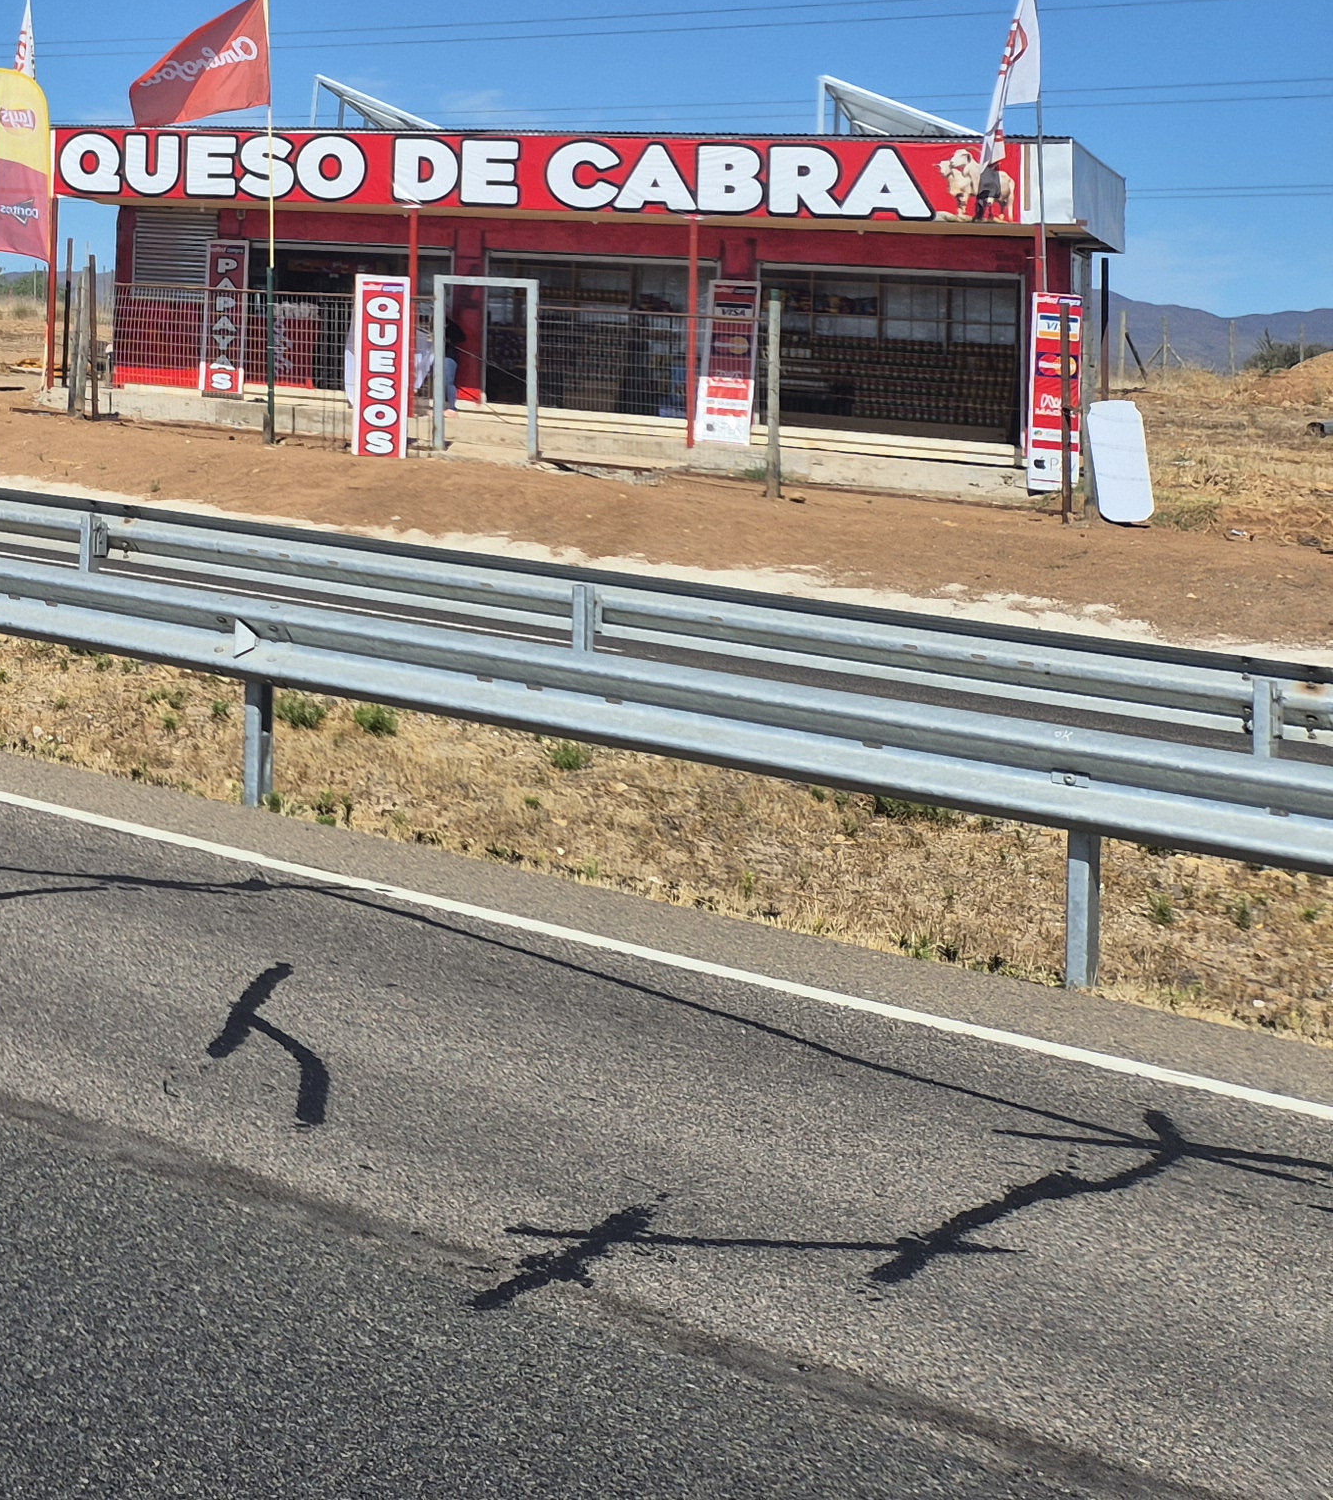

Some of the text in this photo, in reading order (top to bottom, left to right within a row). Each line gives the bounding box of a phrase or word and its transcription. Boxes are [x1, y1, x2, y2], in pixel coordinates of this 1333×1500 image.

[58, 131, 934, 220] QUESO DE CABRA
[209, 257, 238, 390] PAPAYAS
[720, 308, 746, 317] VISA
[1045, 321, 1073, 332] VIA
[362, 296, 401, 456] QUESOS
